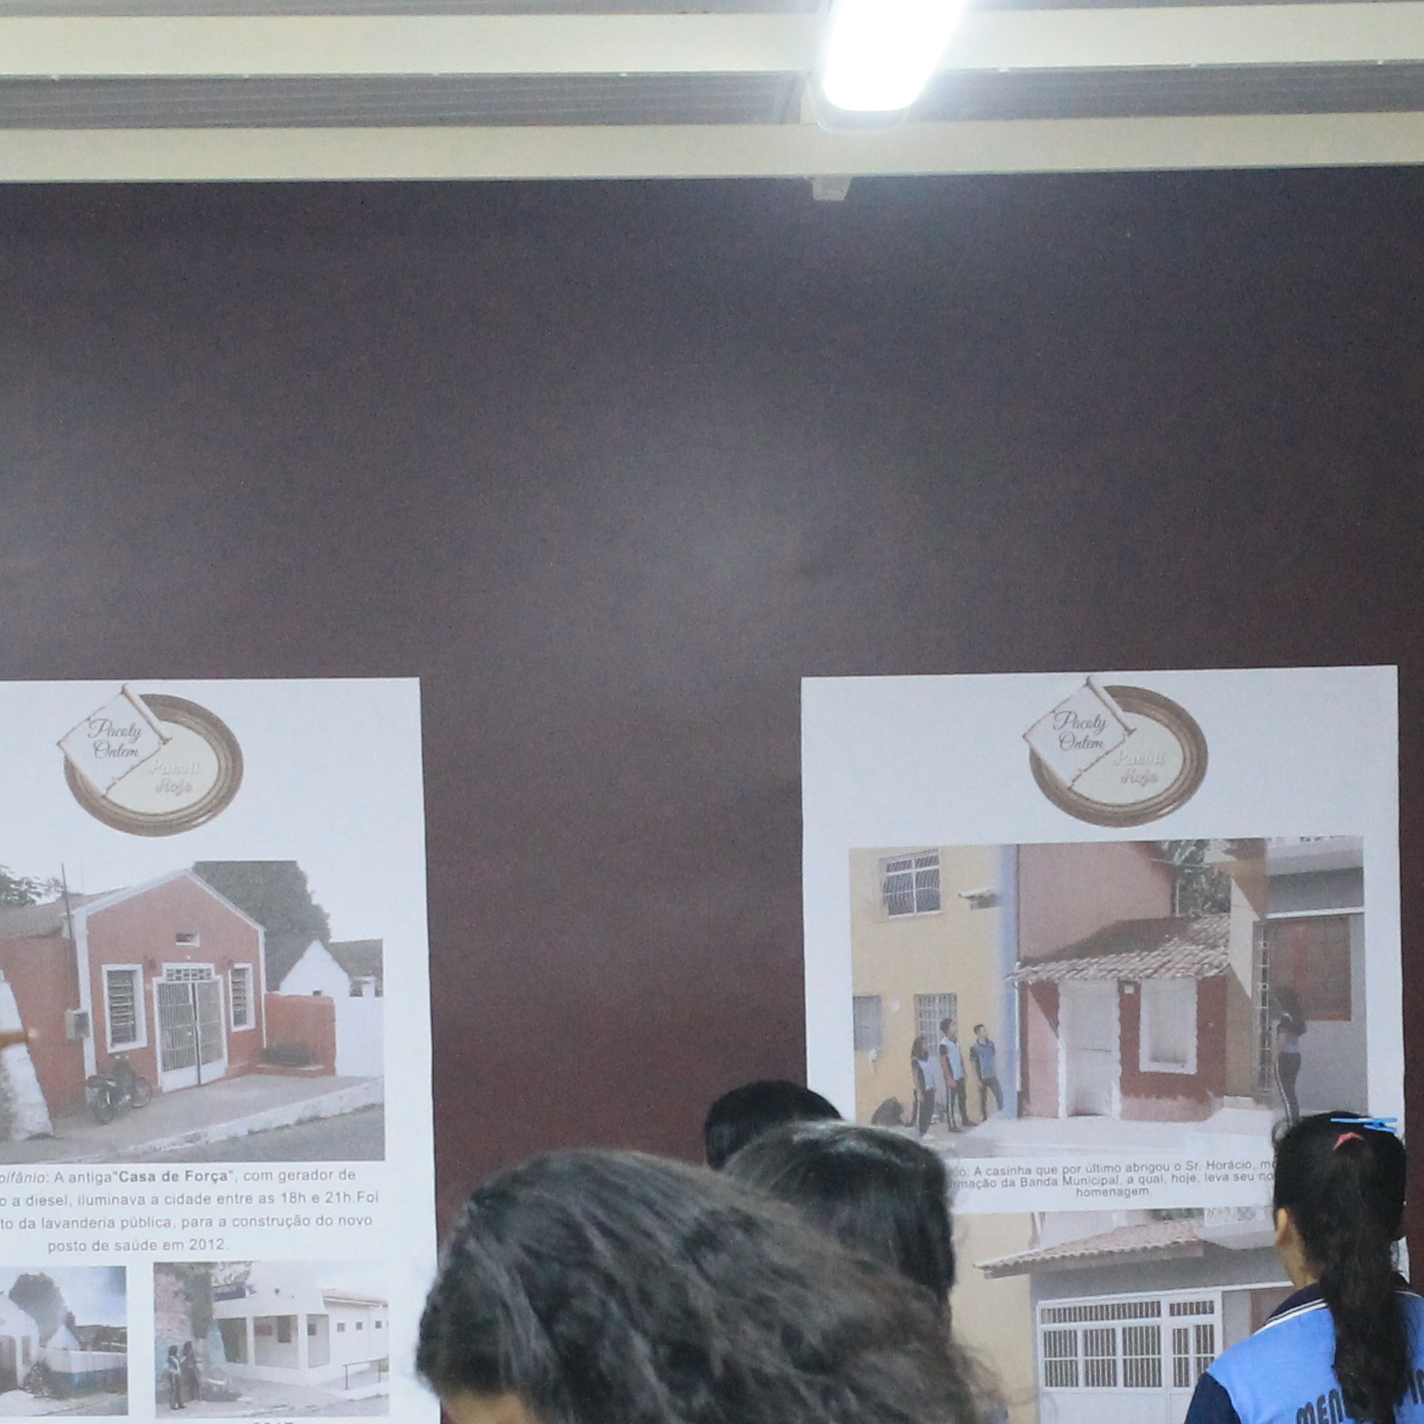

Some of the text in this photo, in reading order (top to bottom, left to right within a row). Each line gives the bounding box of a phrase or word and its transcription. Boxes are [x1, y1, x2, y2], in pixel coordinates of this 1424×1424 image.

[1053, 710, 1108, 736] Pacoty
[93, 740, 140, 760] Ontem
[1058, 732, 1104, 751] Ontem
[54, 1171, 65, 1183] A
[161, 1169, 179, 1183] de
[243, 1171, 273, 1182] com
[278, 1169, 334, 1184] gerador
[338, 1168, 356, 1181] de
[973, 1166, 982, 1176] A
[986, 1165, 1032, 1177] casinha
[1036, 1167, 1058, 1178] que
[1062, 1165, 1081, 1177] por
[1086, 1163, 1121, 1174] último
[1126, 1162, 1170, 1174] abrigou
[1174, 1163, 1181, 1171] o
[1001, 1177, 1016, 1188] da
[1020, 1176, 1058, 1188] Banda
[1127, 1176, 1134, 1184] a
[1205, 1172, 1229, 1182] leva
[1233, 1173, 1255, 1181] seu
[12, 1197, 21, 1207] a
[26, 1194, 73, 1209] diesel,
[77, 1193, 145, 1207] iluminava
[151, 1195, 159, 1205] a
[164, 1192, 211, 1205] cidade
[217, 1193, 253, 1205] entre
[259, 1194, 275, 1204] as
[281, 1192, 306, 1204] 18h
[312, 1194, 320, 1203] e
[18, 1217, 36, 1230] da
[41, 1216, 116, 1229] lavanderia
[181, 1217, 213, 1230] para
[218, 1217, 227, 1227] a
[232, 1214, 311, 1229] construção
[316, 1213, 333, 1226] do
[338, 1215, 373, 1226] novo
[48, 1240, 87, 1254] posto
[91, 1239, 109, 1252] de
[114, 1238, 157, 1251] saúde
[162, 1240, 184, 1250] em
